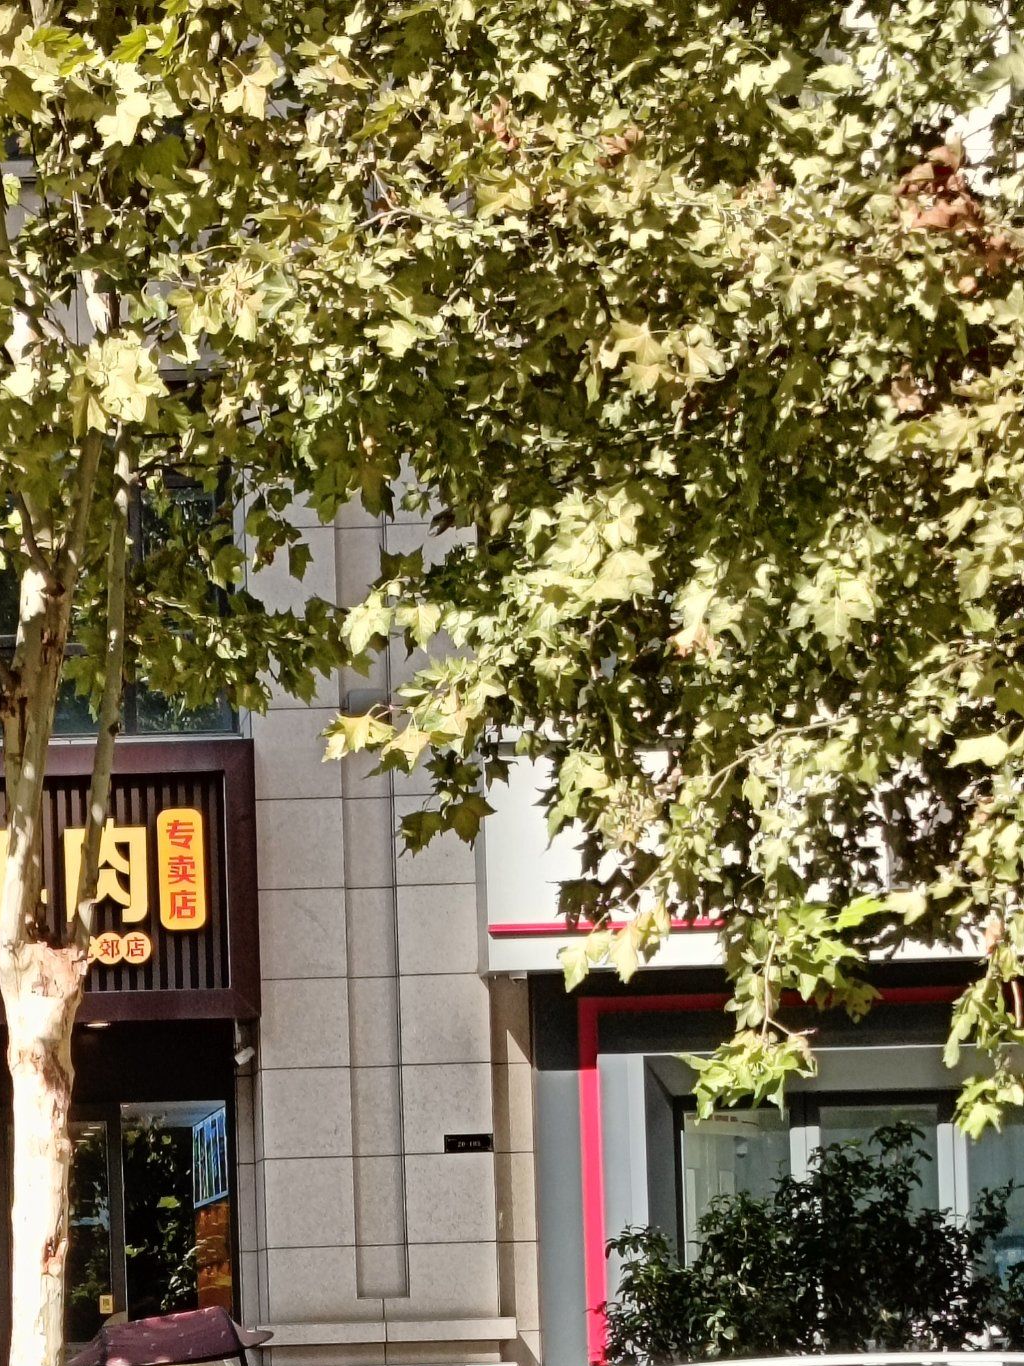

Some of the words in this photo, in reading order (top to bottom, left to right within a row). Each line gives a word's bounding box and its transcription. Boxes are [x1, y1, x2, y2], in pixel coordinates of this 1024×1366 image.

[166, 819, 197, 920] 专卖店
[87, 936, 146, 959] 郊店
